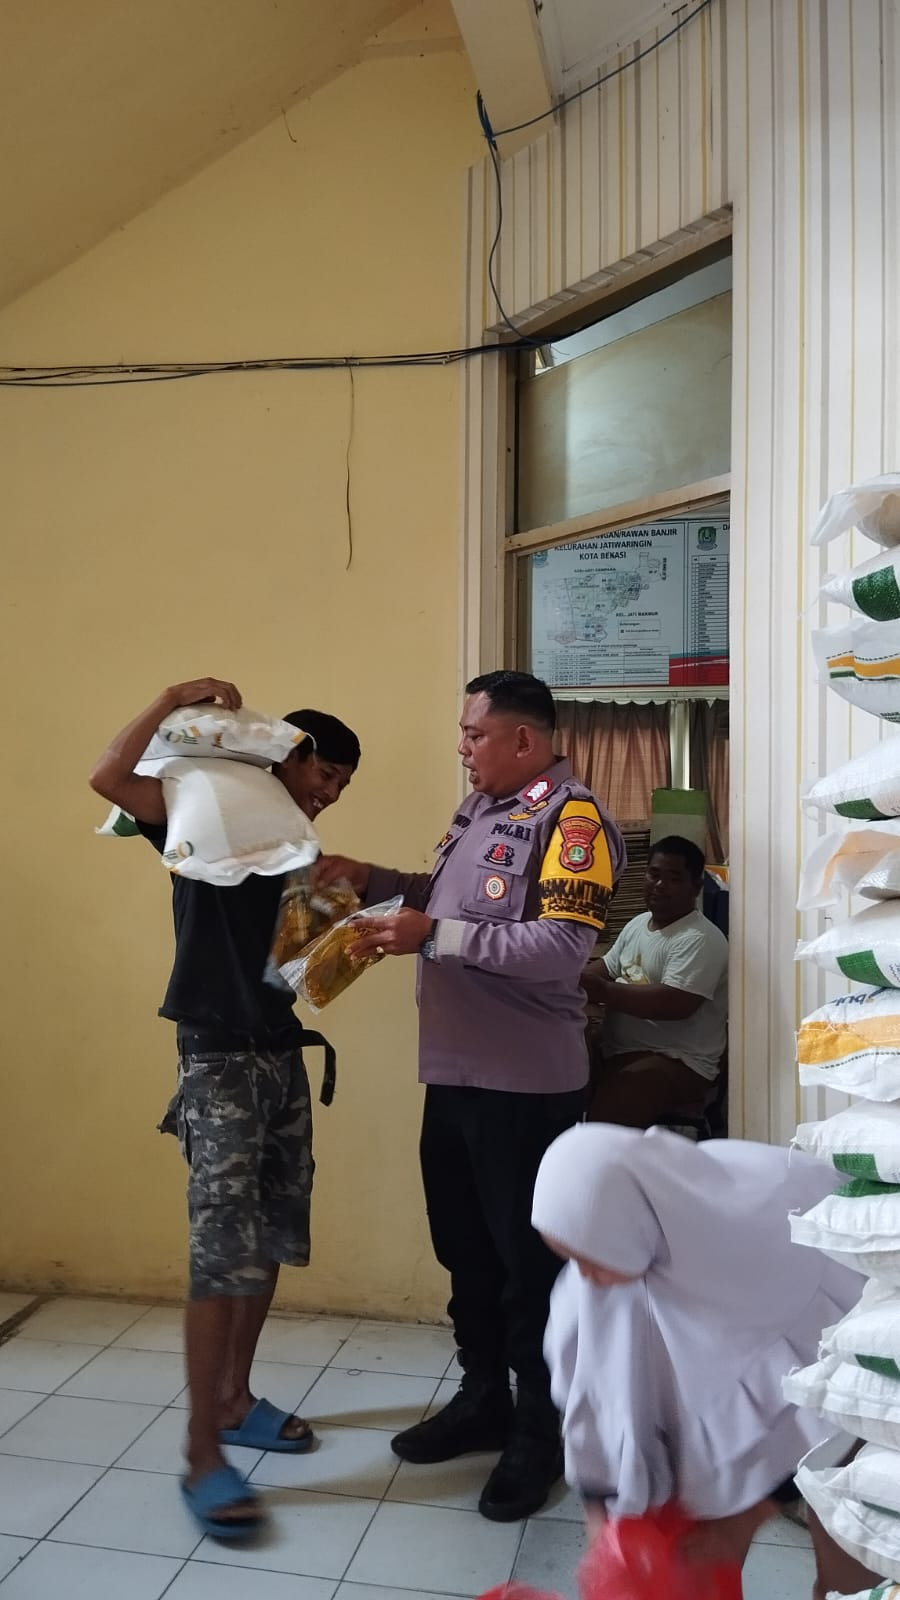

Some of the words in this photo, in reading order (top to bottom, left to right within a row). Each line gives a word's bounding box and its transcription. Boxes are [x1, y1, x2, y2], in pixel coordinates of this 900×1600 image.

[651, 528, 678, 537] BANJIR
[554, 542, 598, 551] KELURAHAN
[600, 540, 652, 550] JATIWARINGIN
[579, 552, 599, 560] KOTA
[600, 551, 626, 559] BEKASI
[490, 823, 532, 841] POLRI
